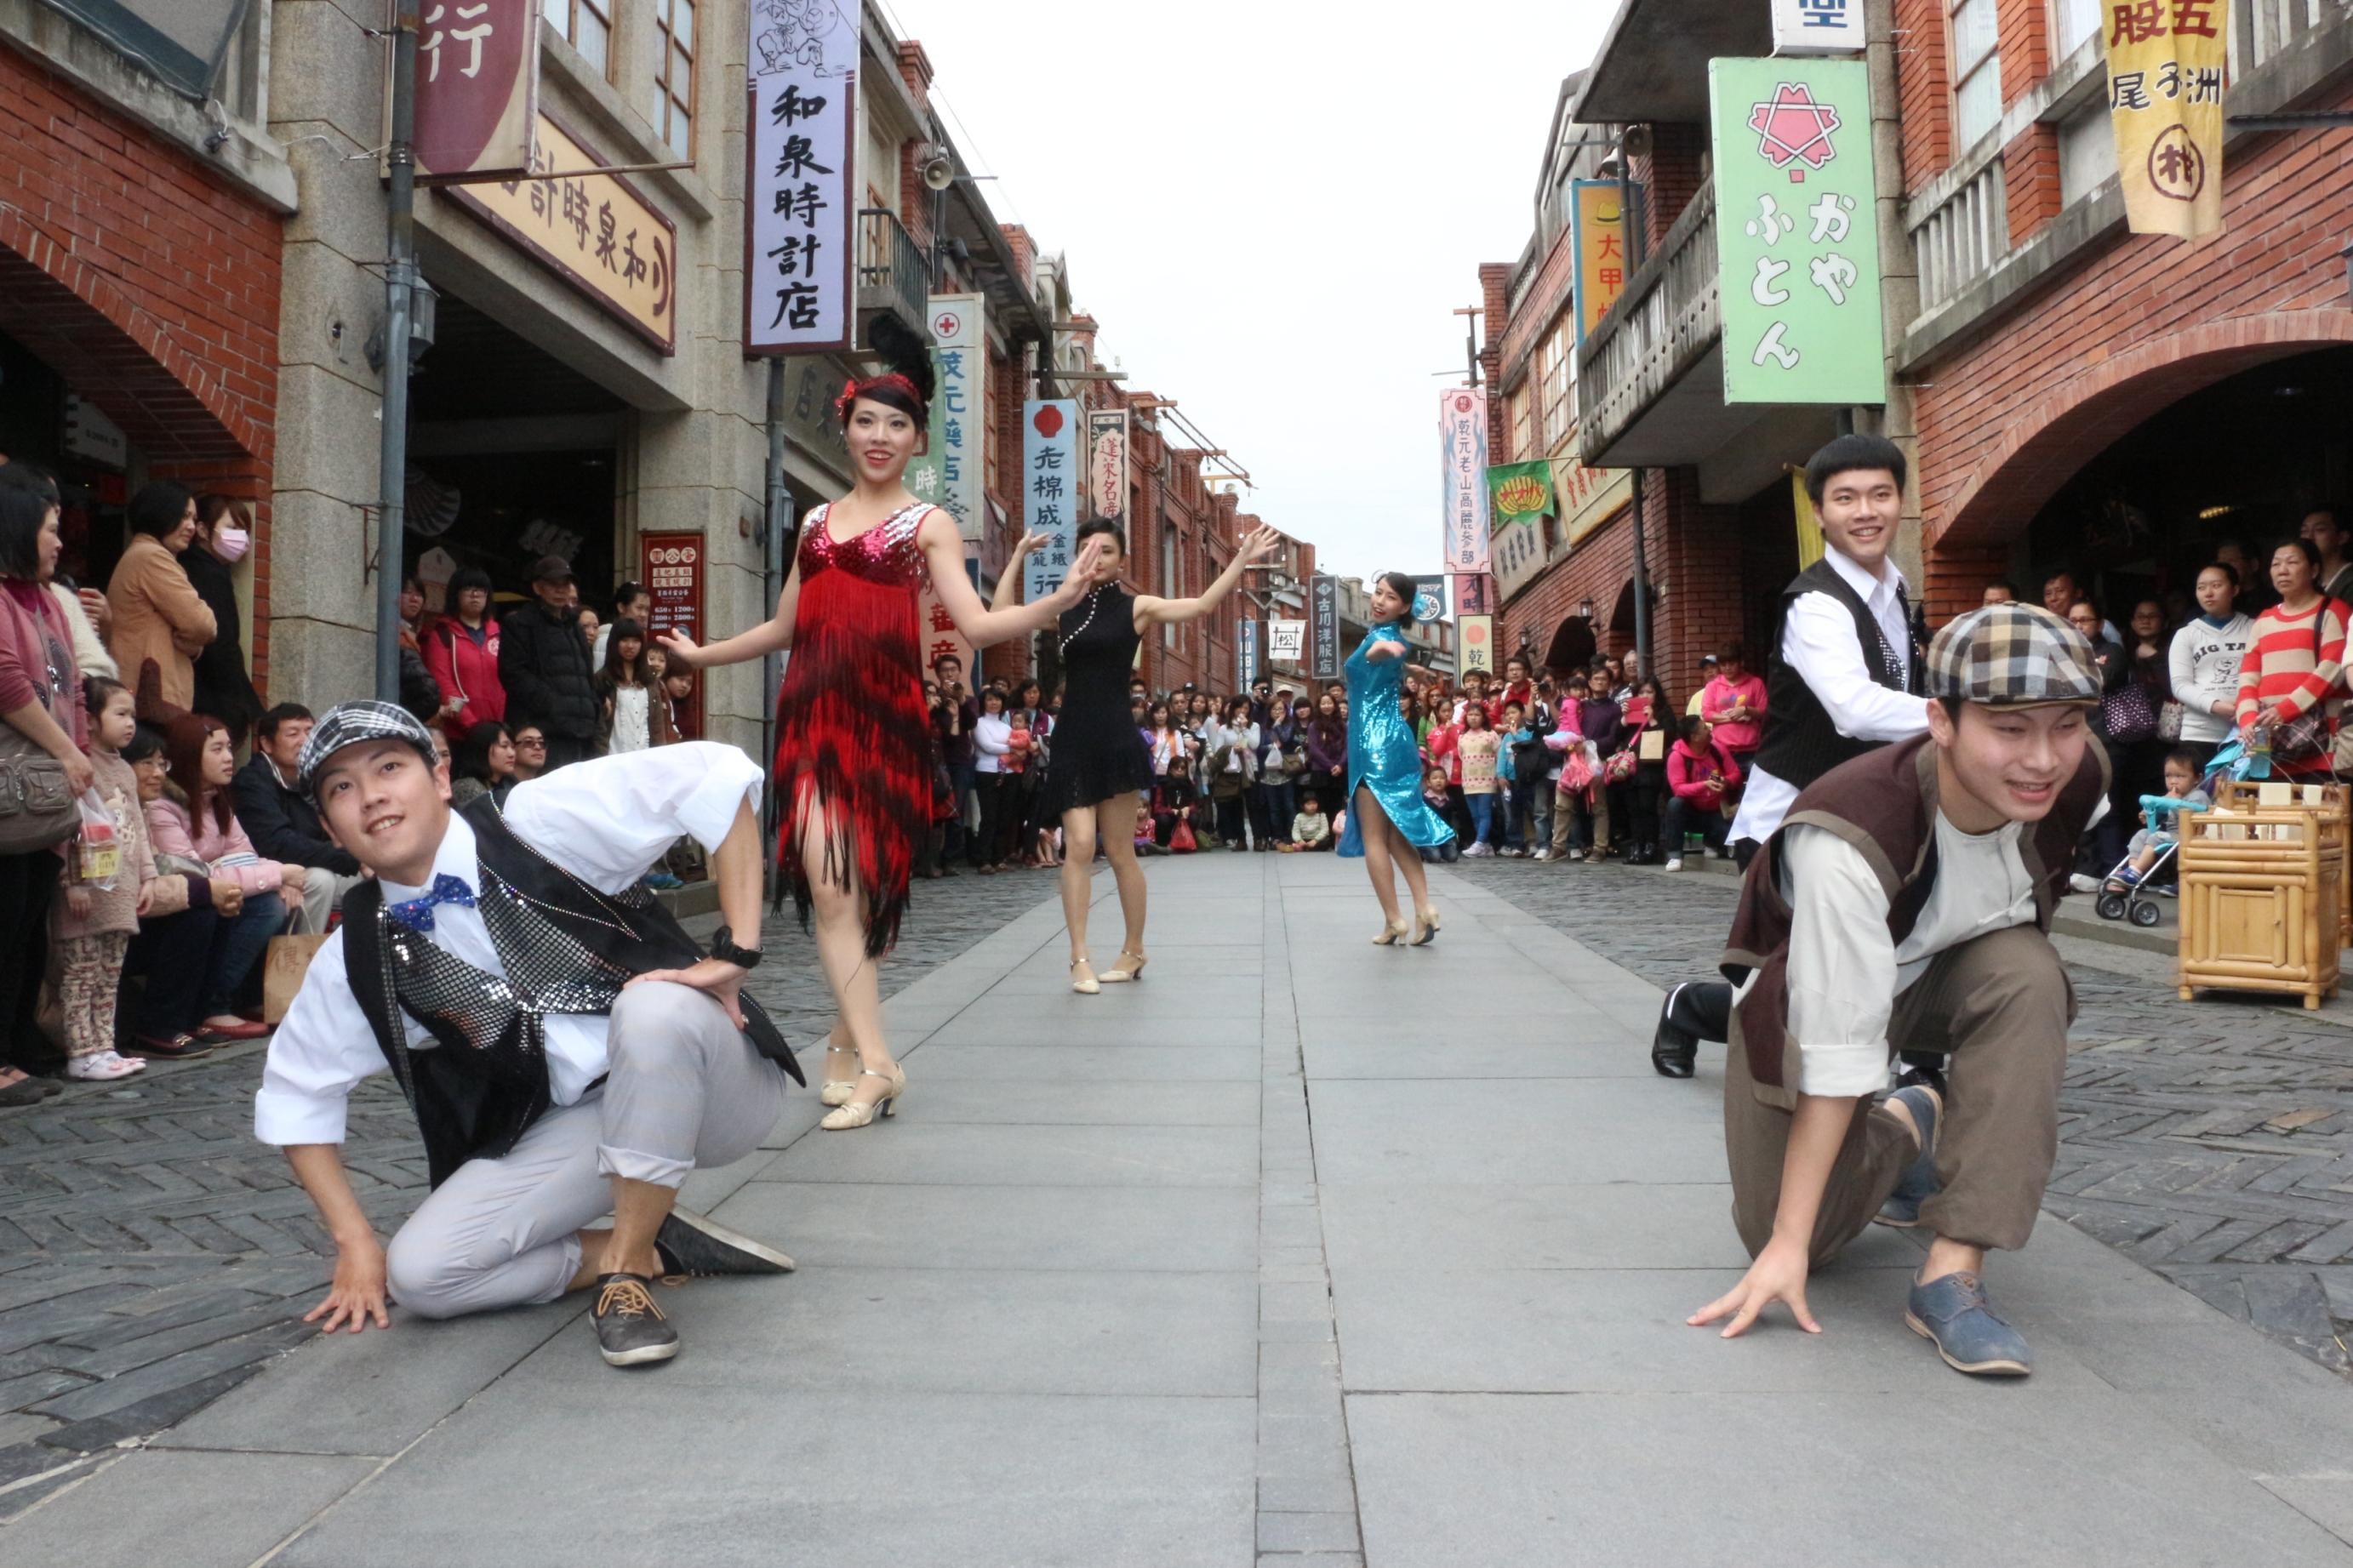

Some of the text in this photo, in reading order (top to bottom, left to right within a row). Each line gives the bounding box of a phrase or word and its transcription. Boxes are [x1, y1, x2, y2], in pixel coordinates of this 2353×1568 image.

[420, 3, 494, 83] 行
[500, 140, 647, 288] 和泉時計
[768, 85, 835, 330] 和泉時計店
[1809, 192, 1858, 305] かや
[1597, 234, 1622, 322] 大甲
[1745, 193, 1800, 370] ふとん
[1316, 598, 1333, 674] 古川洋服店
[1468, 648, 1485, 670] 乾
[2193, 644, 2219, 664] BIG
